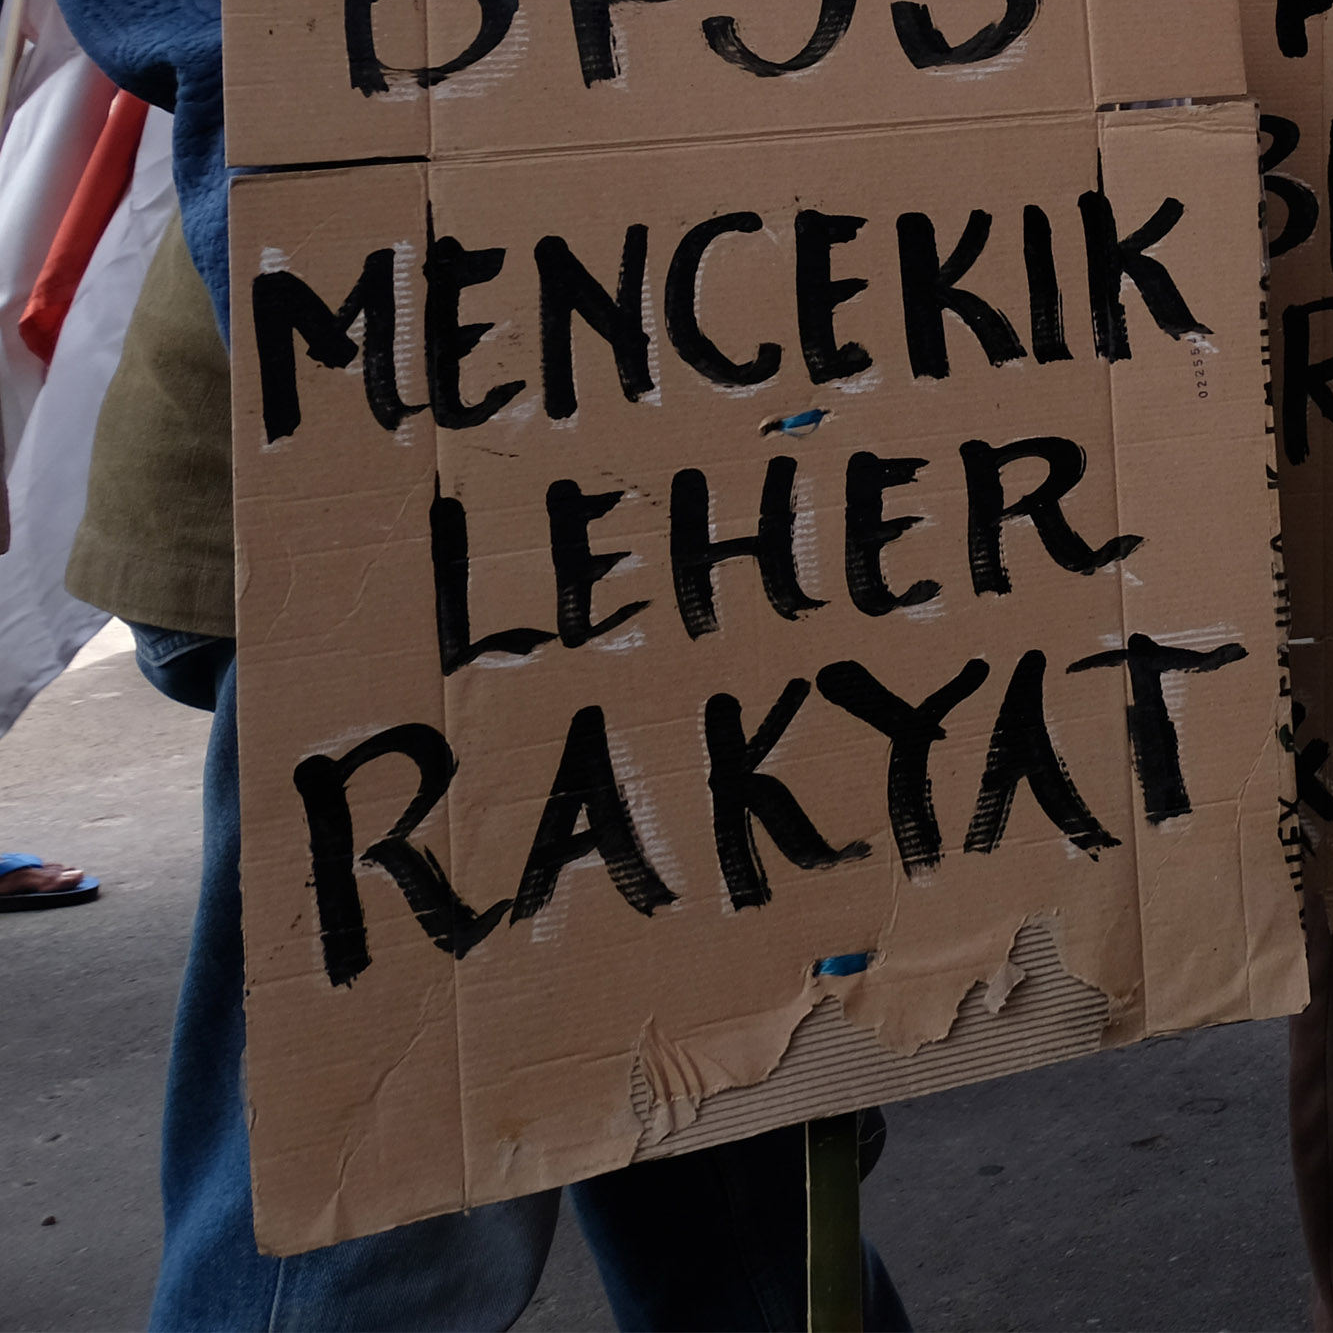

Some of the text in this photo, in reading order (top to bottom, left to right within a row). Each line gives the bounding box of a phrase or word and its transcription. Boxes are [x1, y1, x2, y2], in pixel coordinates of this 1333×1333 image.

[251, 187, 1214, 445] MENCEKIK
[431, 436, 1148, 676] LEHER
[293, 633, 1249, 989] RAKYAT
